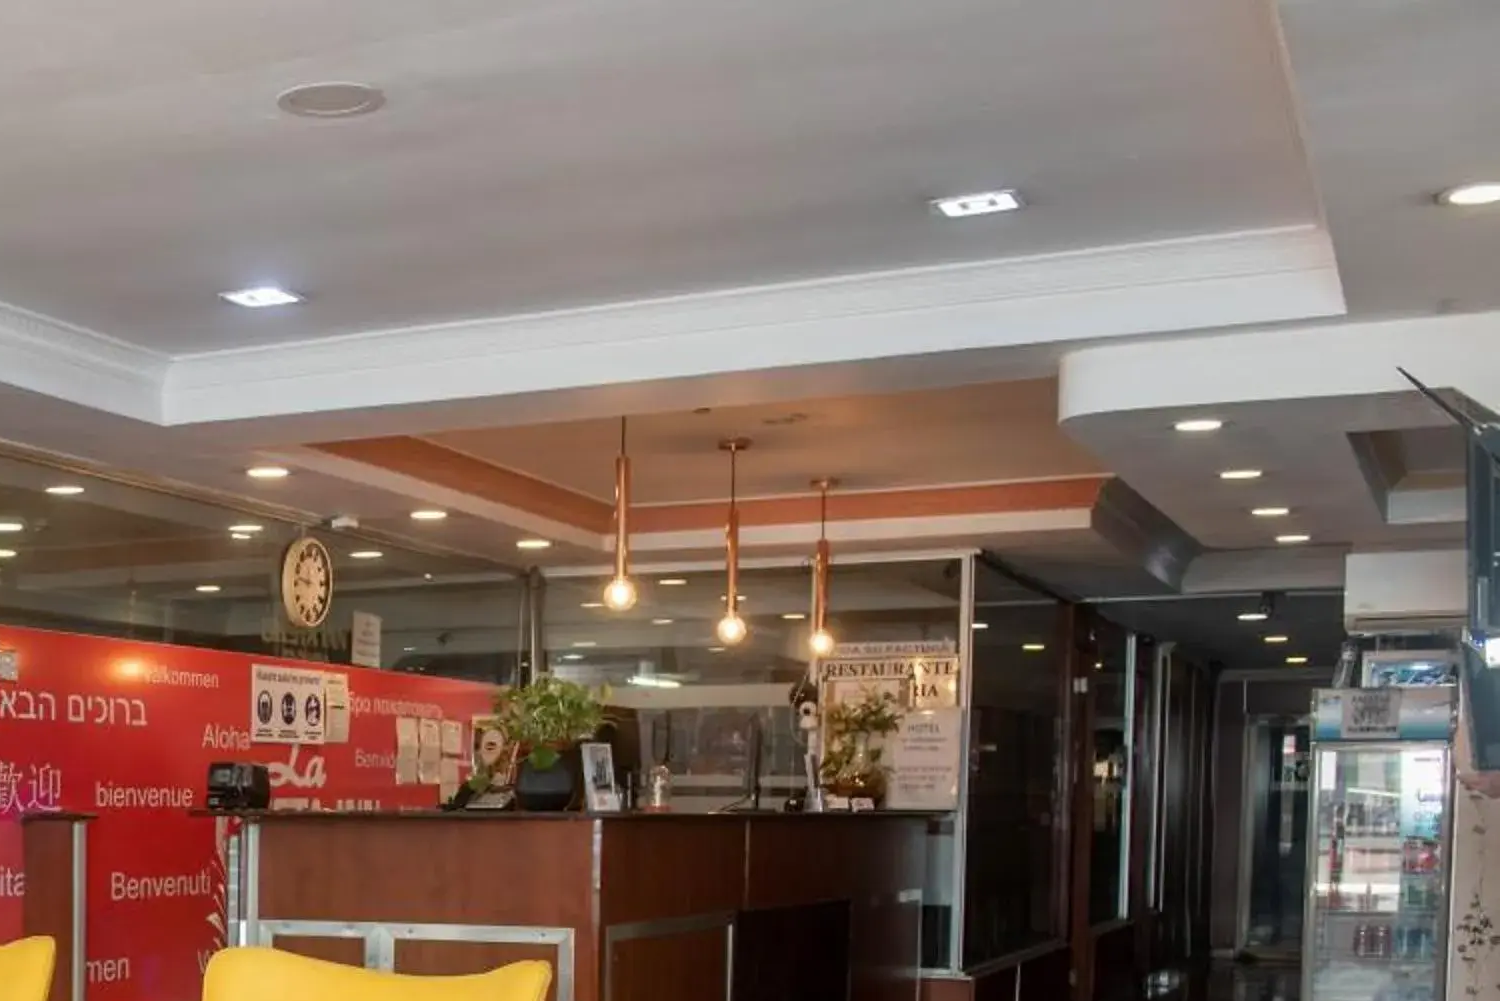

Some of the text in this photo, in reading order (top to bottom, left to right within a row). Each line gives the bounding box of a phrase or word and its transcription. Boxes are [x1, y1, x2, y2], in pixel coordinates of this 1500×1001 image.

[826, 661, 954, 677] RESTAURANTE
[67, 692, 149, 727] ברוכים
[202, 723, 251, 751] Aloha
[95, 781, 194, 808] bienvenue
[111, 868, 212, 901] Benvenuti
[86, 956, 131, 983] men
